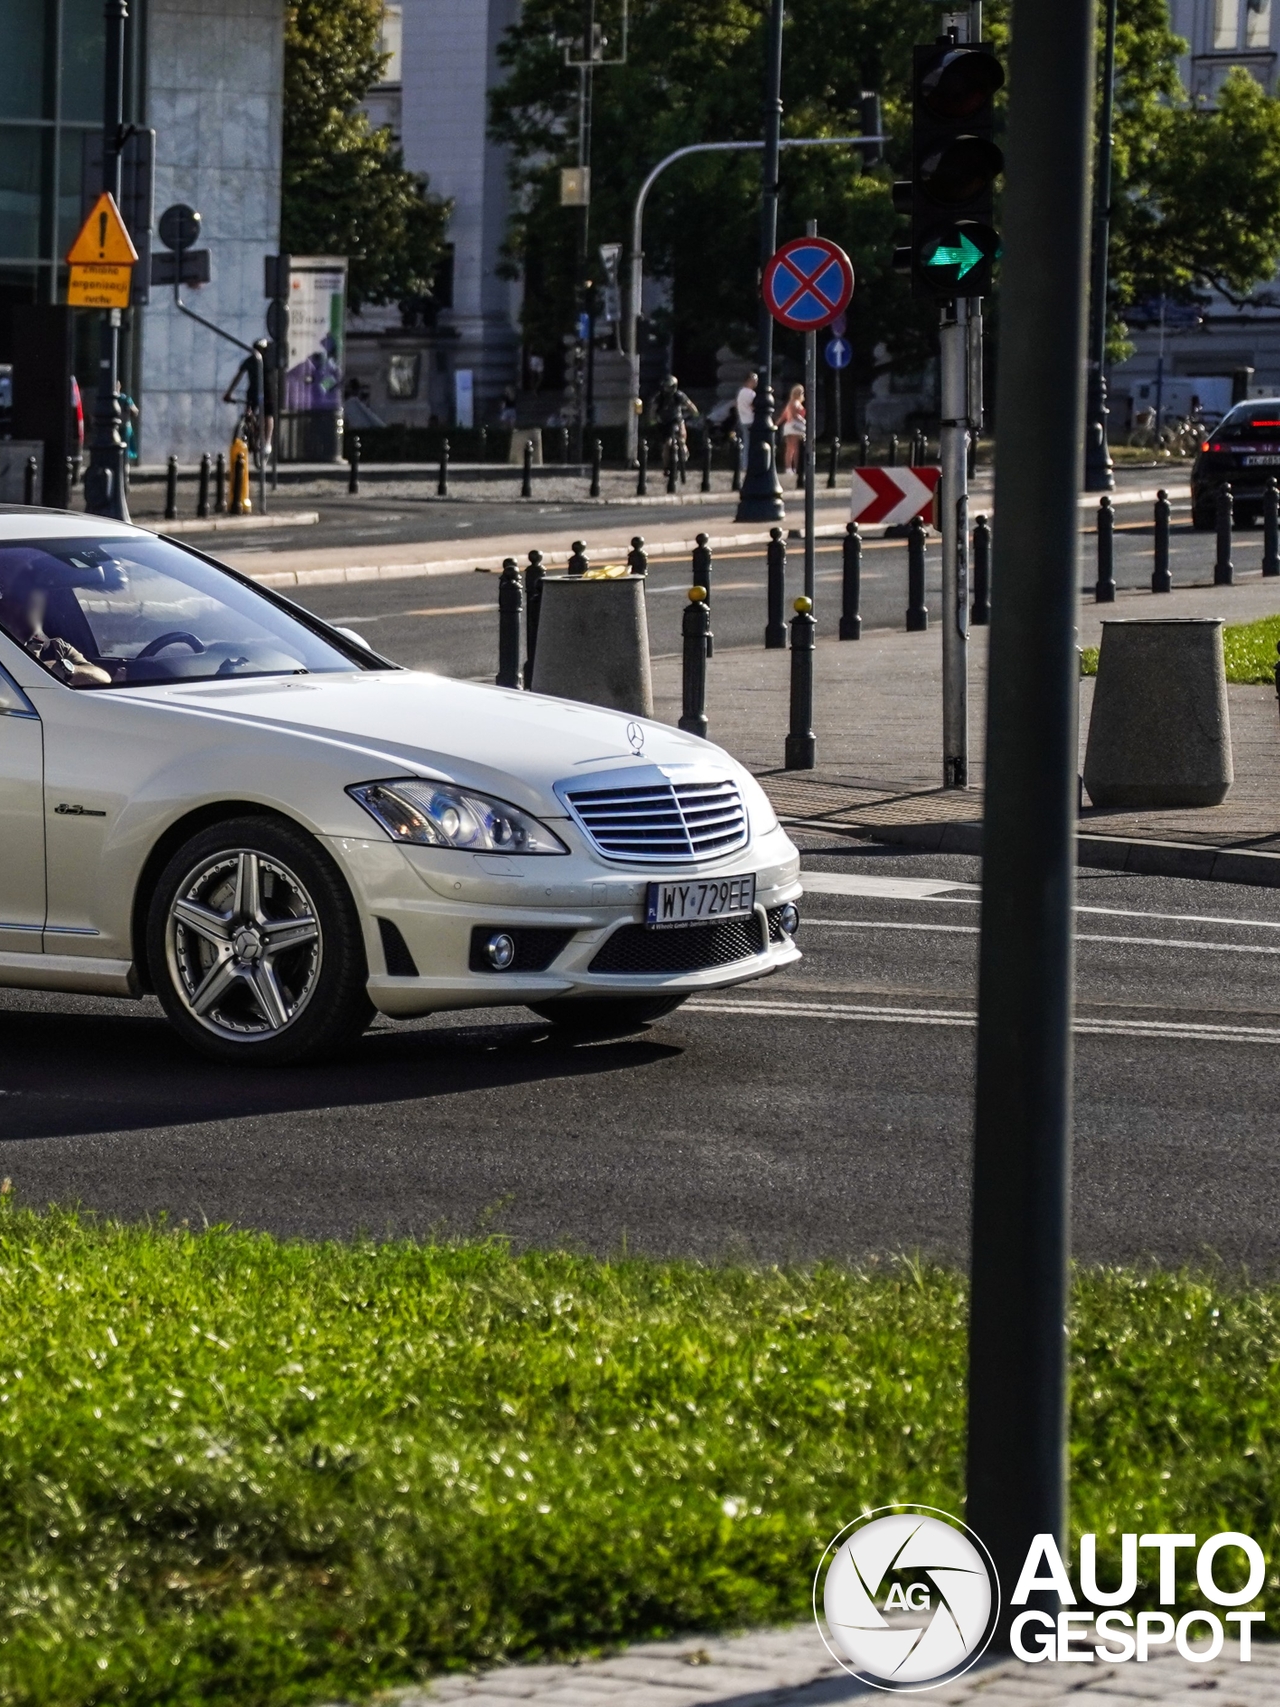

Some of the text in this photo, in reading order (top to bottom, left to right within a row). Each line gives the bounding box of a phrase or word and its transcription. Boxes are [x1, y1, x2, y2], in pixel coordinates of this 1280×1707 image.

[72, 281, 127, 293] organizacji
[663, 880, 751, 918] WY 729EE
[648, 908, 656, 917] PL
